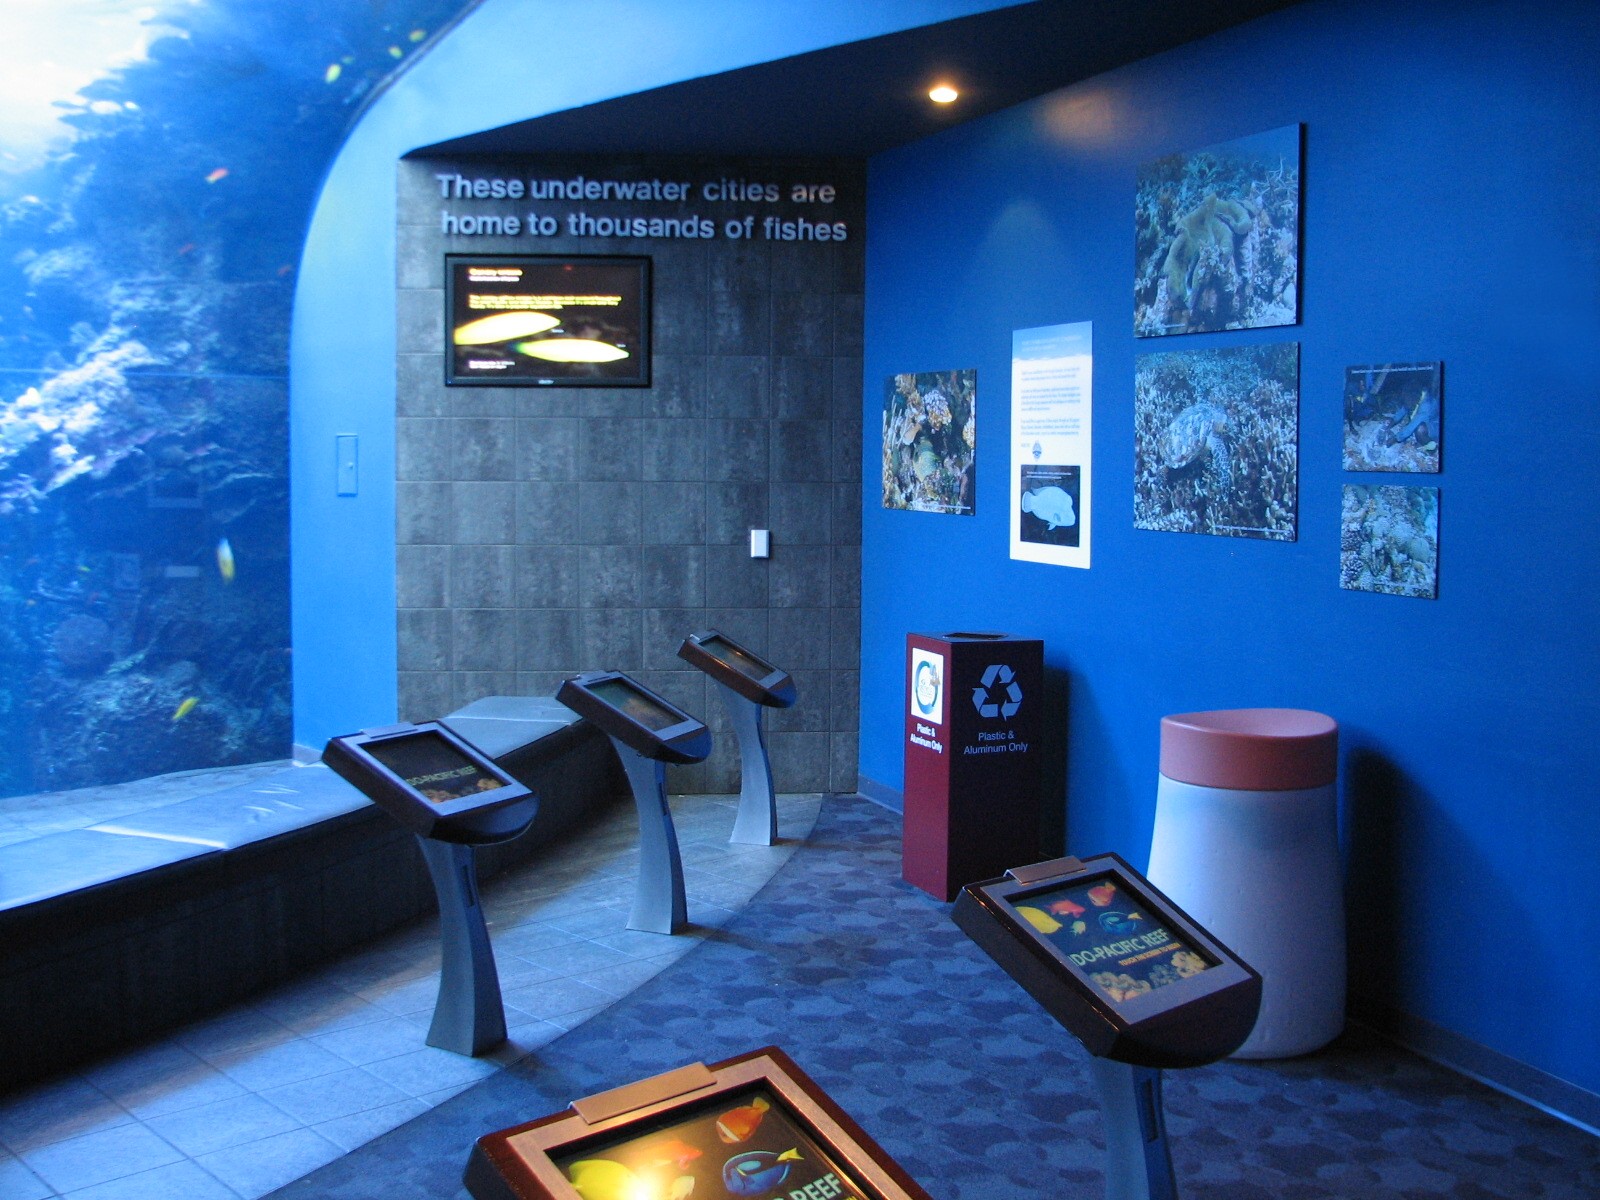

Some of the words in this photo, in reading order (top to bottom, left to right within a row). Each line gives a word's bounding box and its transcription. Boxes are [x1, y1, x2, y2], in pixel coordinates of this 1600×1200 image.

[437, 173, 525, 199] These
[530, 176, 691, 202] underwater
[702, 178, 780, 203] cities
[791, 184, 836, 204] are
[441, 211, 521, 236] home
[528, 214, 558, 237] to
[568, 213, 716, 239] thousands
[724, 216, 755, 239] of
[763, 217, 848, 241] fishes
[978, 731, 1006, 741] Plastic
[1008, 730, 1015, 739] &
[963, 744, 1007, 755] Aluminum
[1008, 742, 1029, 753] Only
[1143, 928, 1169, 947] REEF
